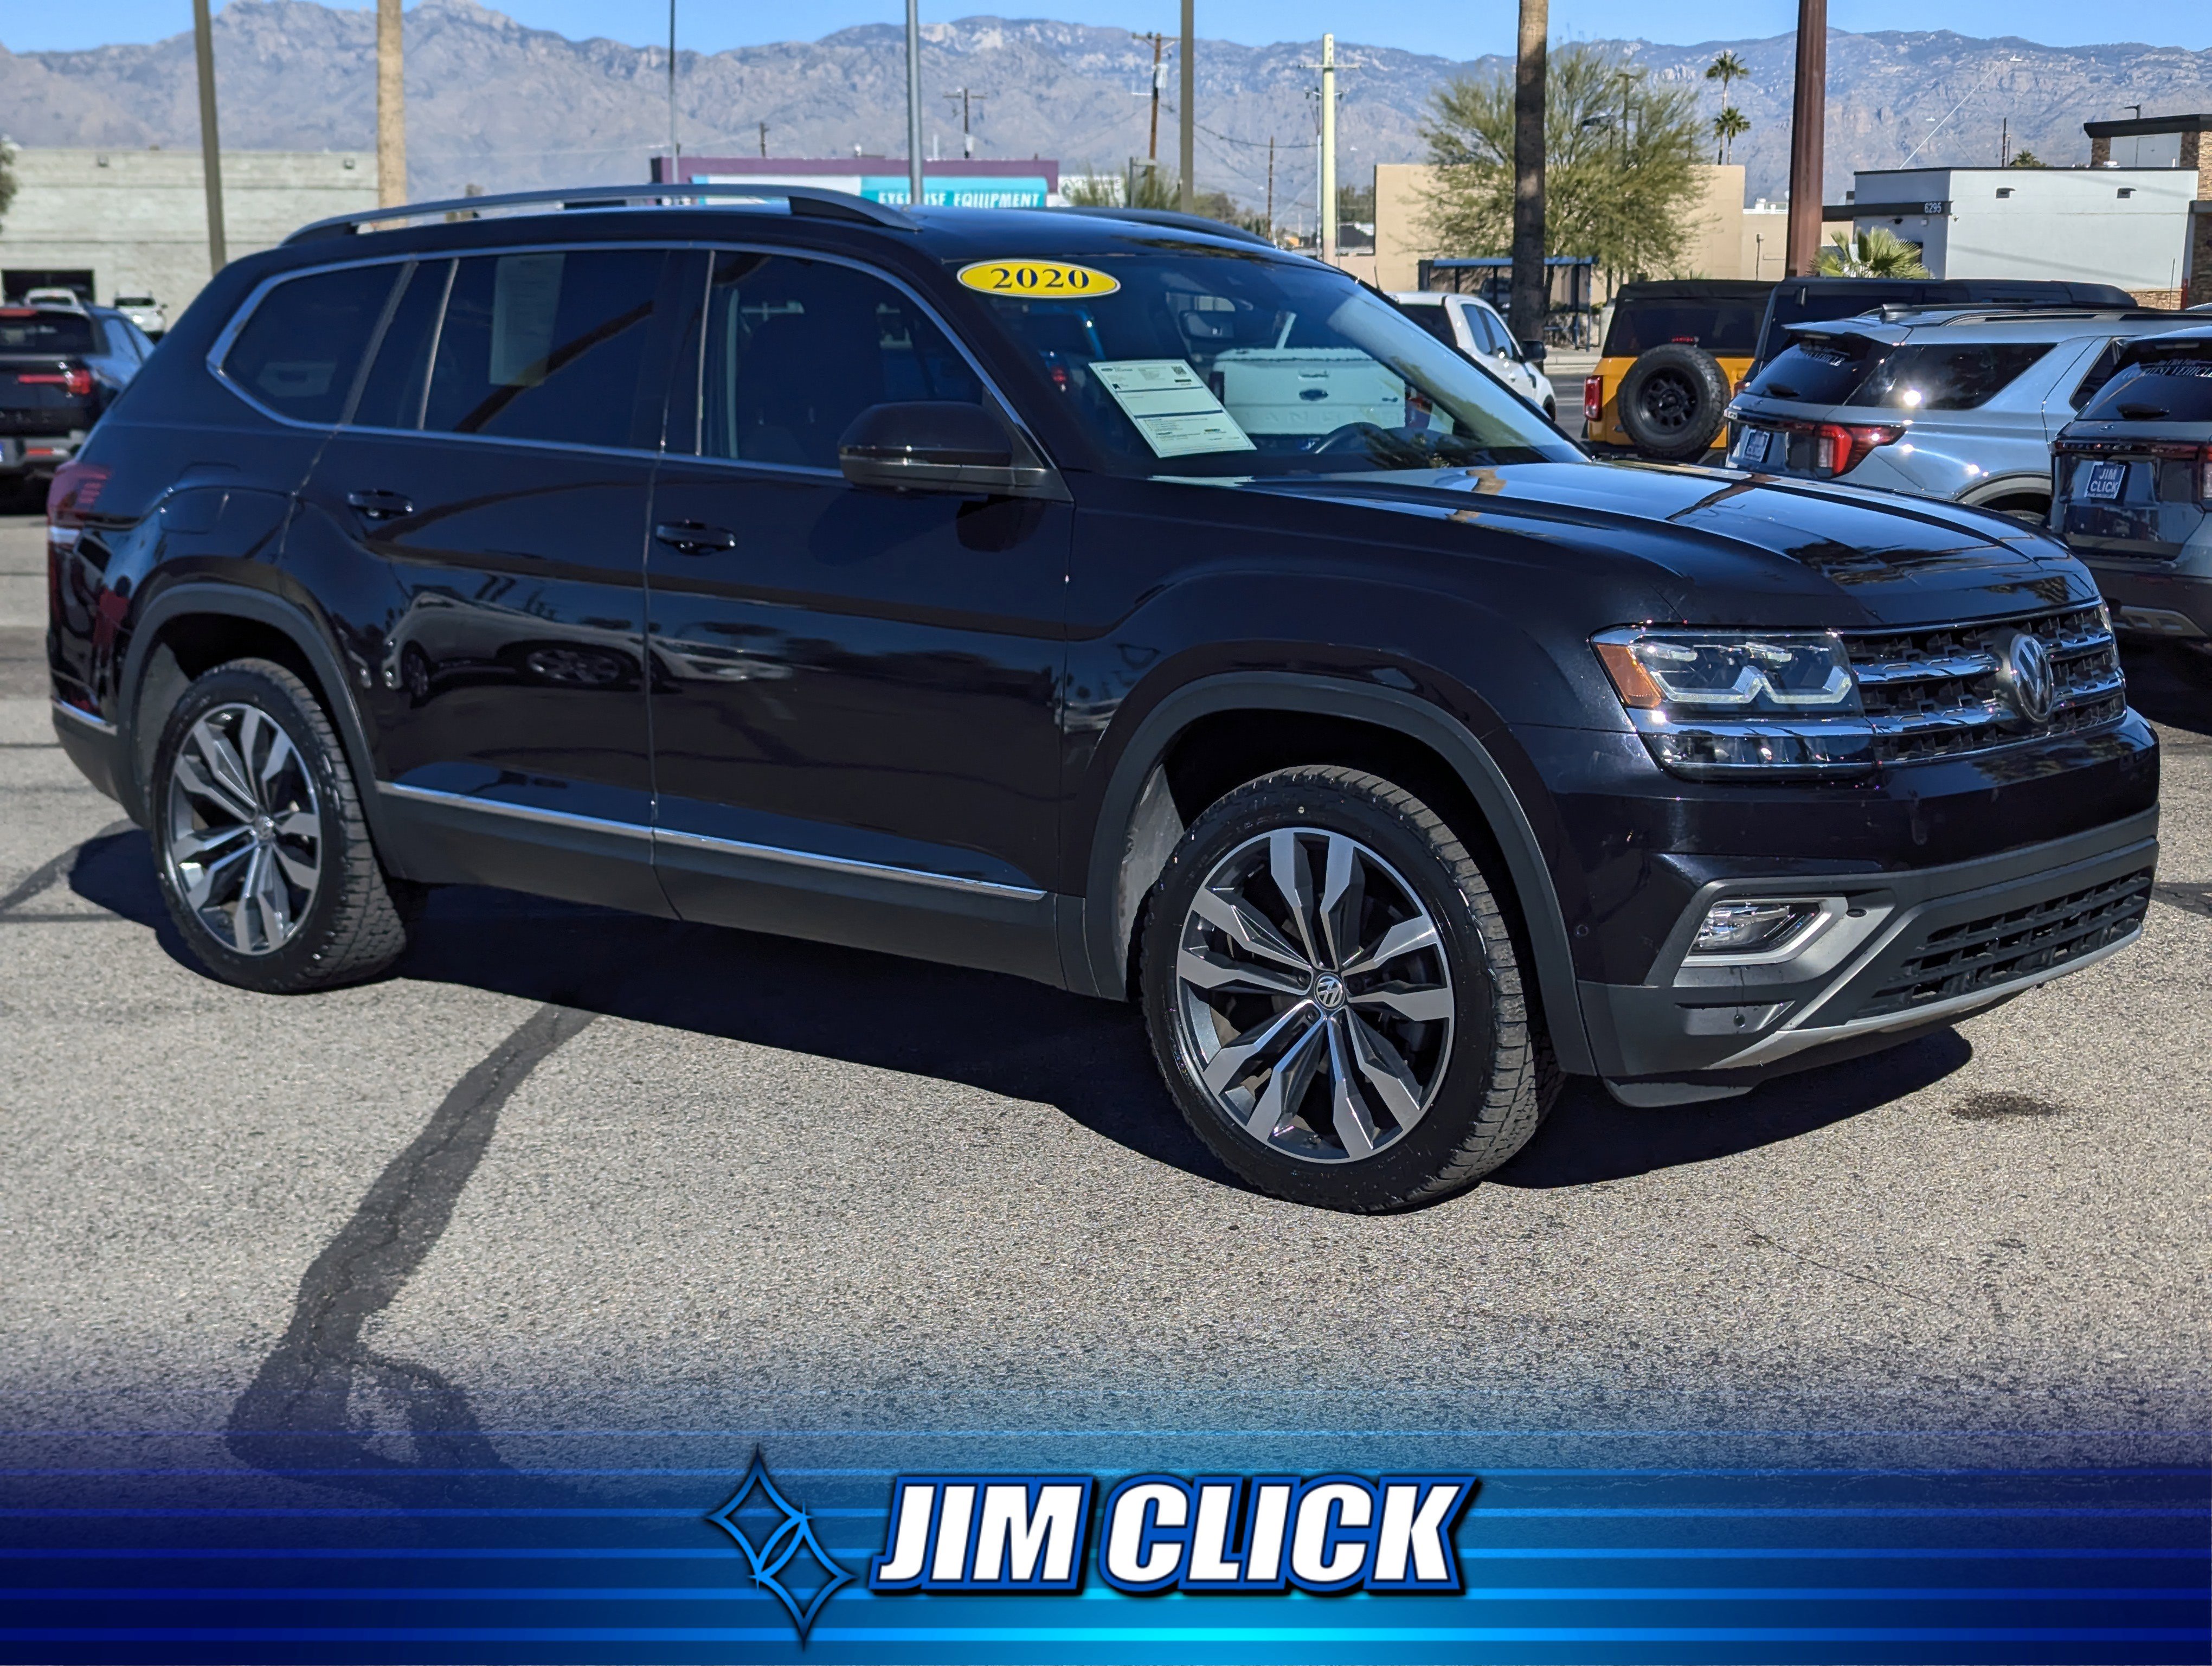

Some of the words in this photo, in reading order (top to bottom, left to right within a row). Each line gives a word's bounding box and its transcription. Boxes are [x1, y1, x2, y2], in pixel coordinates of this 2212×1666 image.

[878, 192, 947, 206] EXEISE
[953, 193, 1040, 209] EQUIPMENT
[1925, 202, 1941, 214] 6295
[991, 268, 1089, 289] 2020
[2099, 468, 2117, 480] JIM
[2090, 480, 2119, 492] CLICK
